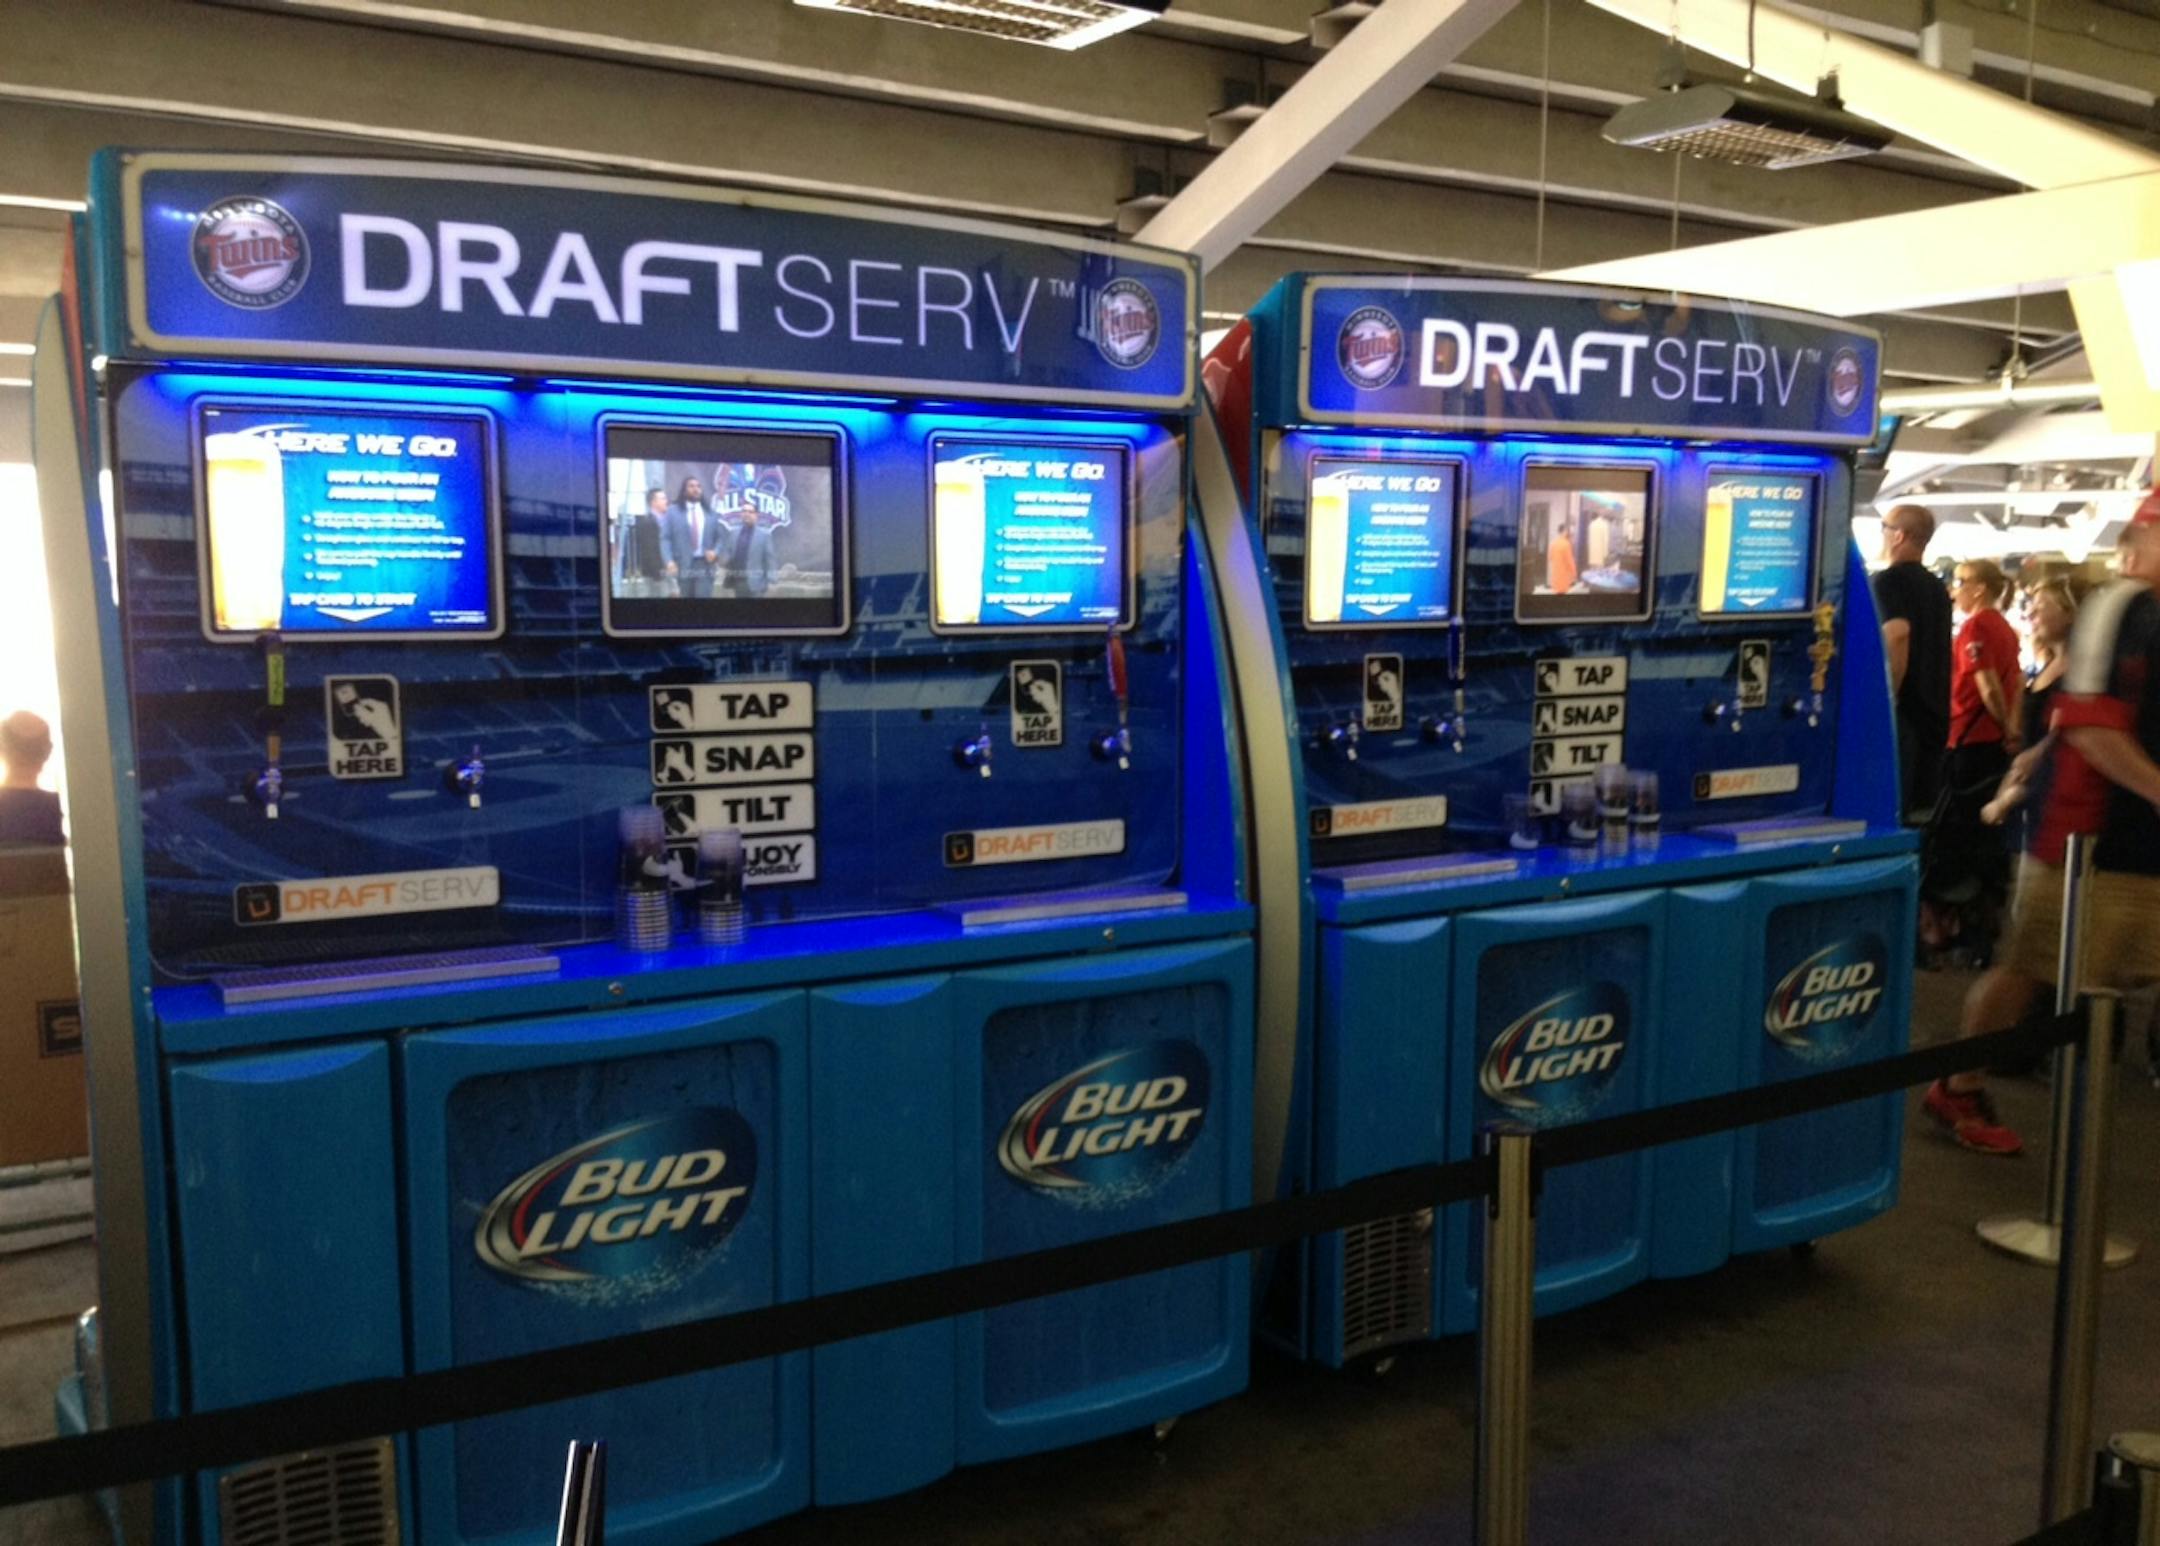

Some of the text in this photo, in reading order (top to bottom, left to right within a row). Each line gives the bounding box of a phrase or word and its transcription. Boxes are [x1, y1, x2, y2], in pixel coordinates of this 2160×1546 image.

[199, 228, 300, 279] Twins
[266, 431, 350, 453] HERE
[355, 434, 404, 455] WE
[717, 488, 786, 519] ALL STAR
[1574, 665, 1614, 686] TAP
[720, 693, 789, 719] TAP
[1373, 703, 1395, 714] TAP
[1562, 705, 1619, 726] SNAP
[1023, 716, 1053, 728] TAP
[1367, 715, 1399, 727] HERE
[1016, 729, 1058, 742] HERE
[343, 742, 389, 757] TAP
[705, 744, 804, 772] SNAP
[1570, 744, 1609, 765] TILT
[336, 758, 397, 774] HERE
[722, 796, 791, 823] TILT
[1802, 961, 1875, 997] BUD
[1781, 987, 1881, 1030] LIGHT
[1524, 1013, 1615, 1053] BUD
[1501, 1042, 1624, 1088] LIGHT
[1061, 1075, 1188, 1124] BUD
[1030, 1108, 1203, 1168] LIGHT
[559, 1149, 726, 1207] BUD
[518, 1186, 747, 1259] LIGHT
